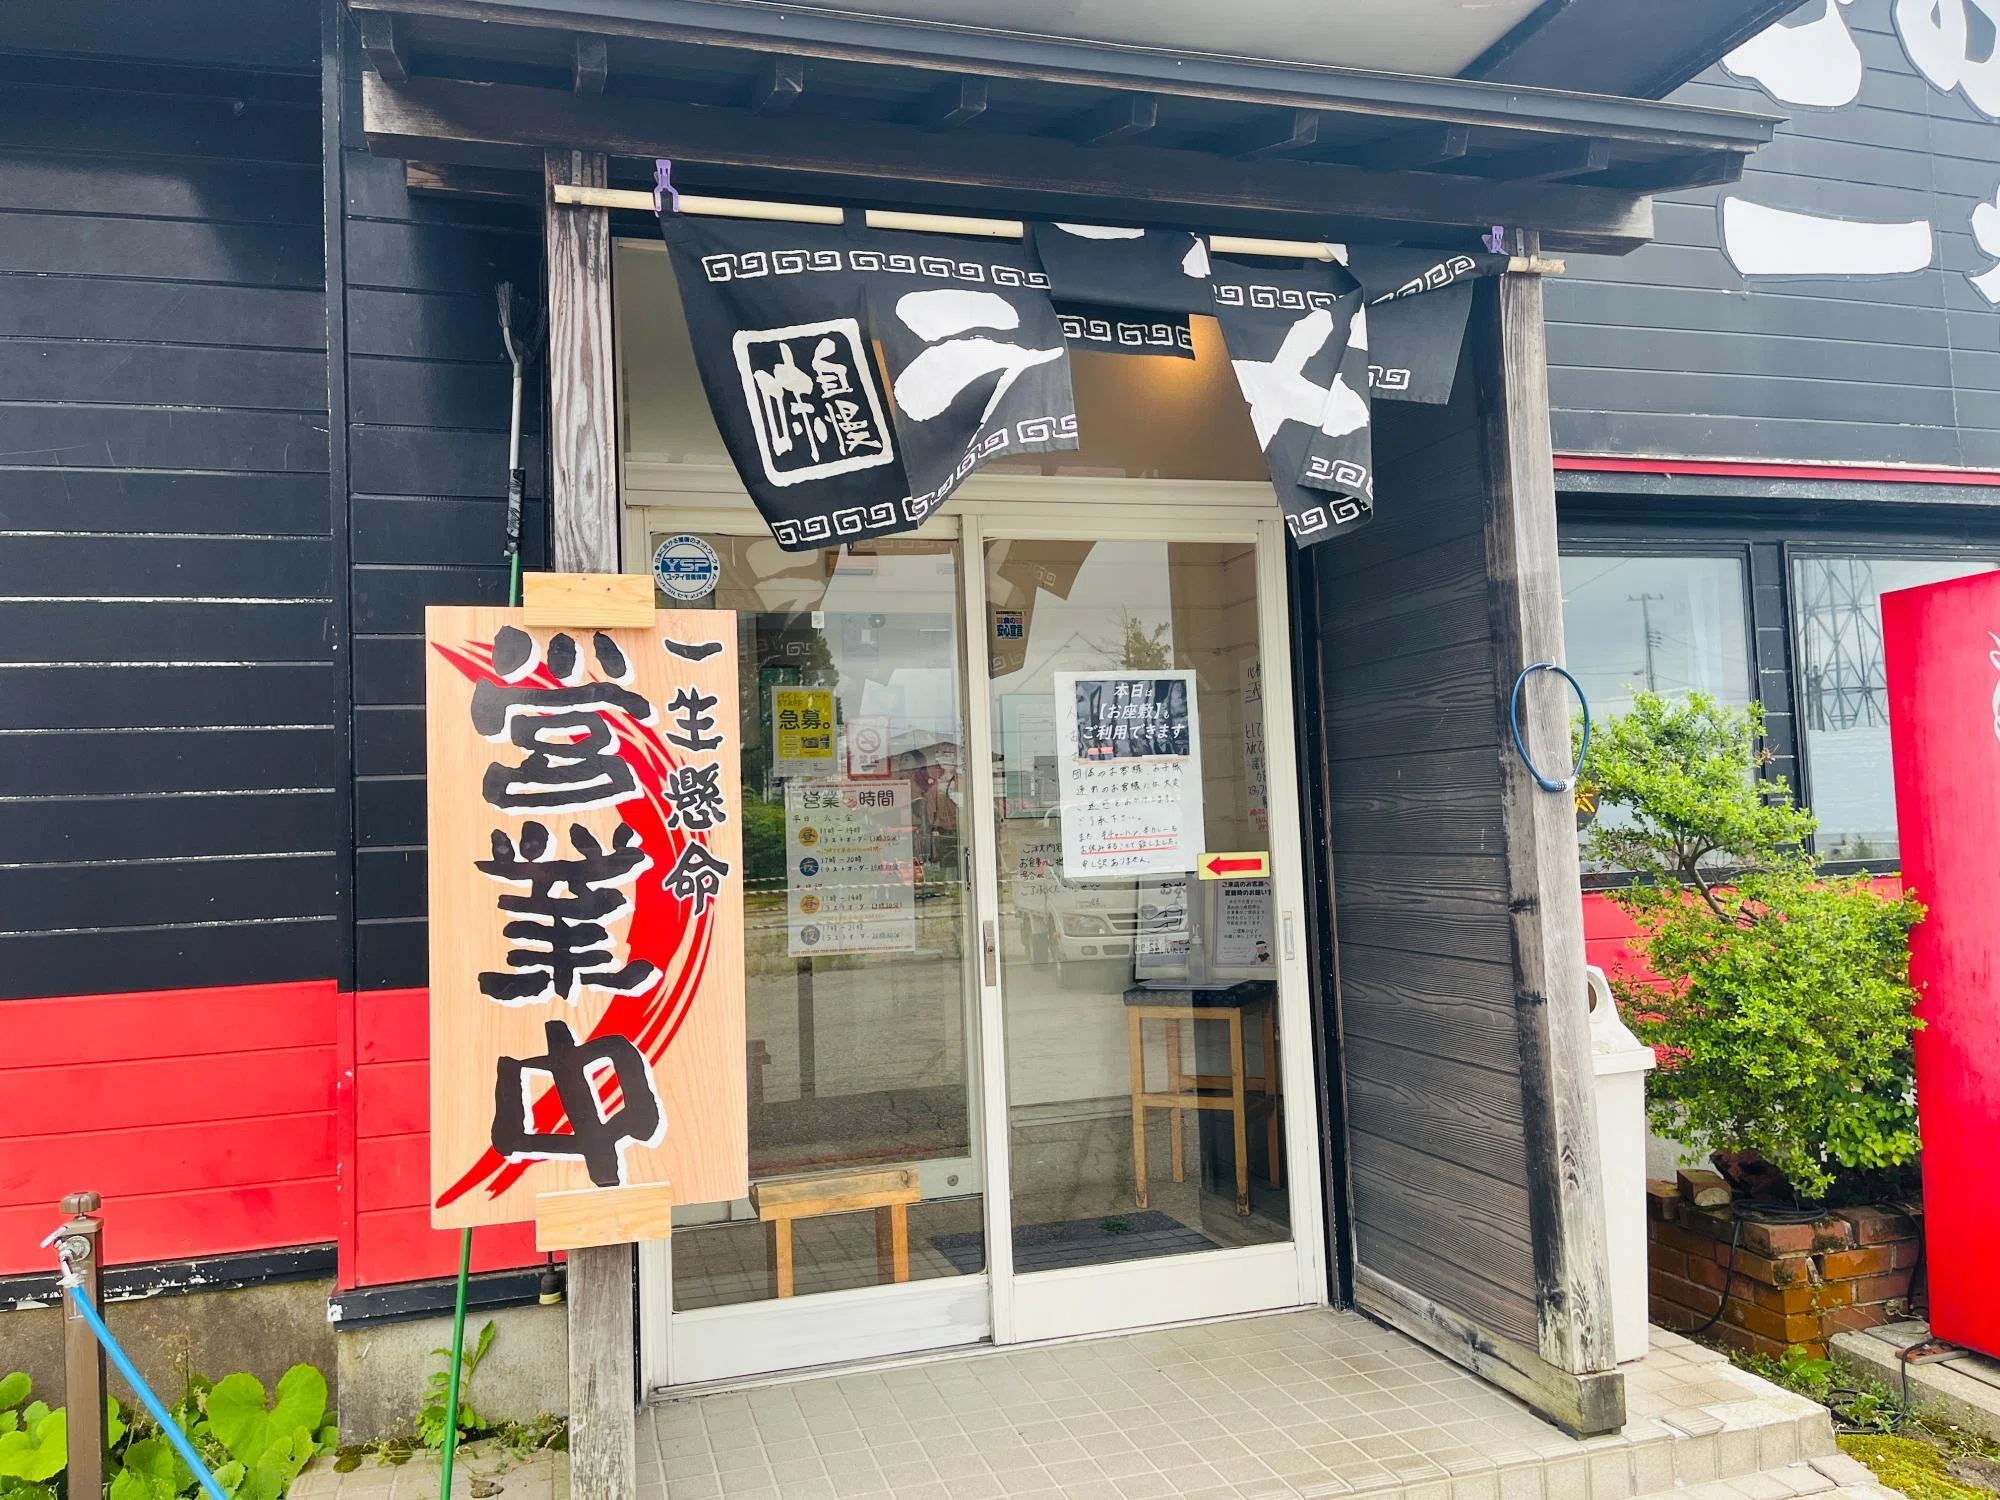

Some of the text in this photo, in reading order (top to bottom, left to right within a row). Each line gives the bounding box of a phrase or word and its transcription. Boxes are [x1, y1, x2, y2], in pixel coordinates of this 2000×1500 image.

[664, 558, 711, 572] YSP
[1113, 684, 1153, 697] 本日は
[1099, 702, 1170, 719] 【お座敷】も
[1083, 724, 1185, 740] ご利用できます
[663, 637, 731, 915] 一生懸命
[471, 624, 663, 1189] 営業中
